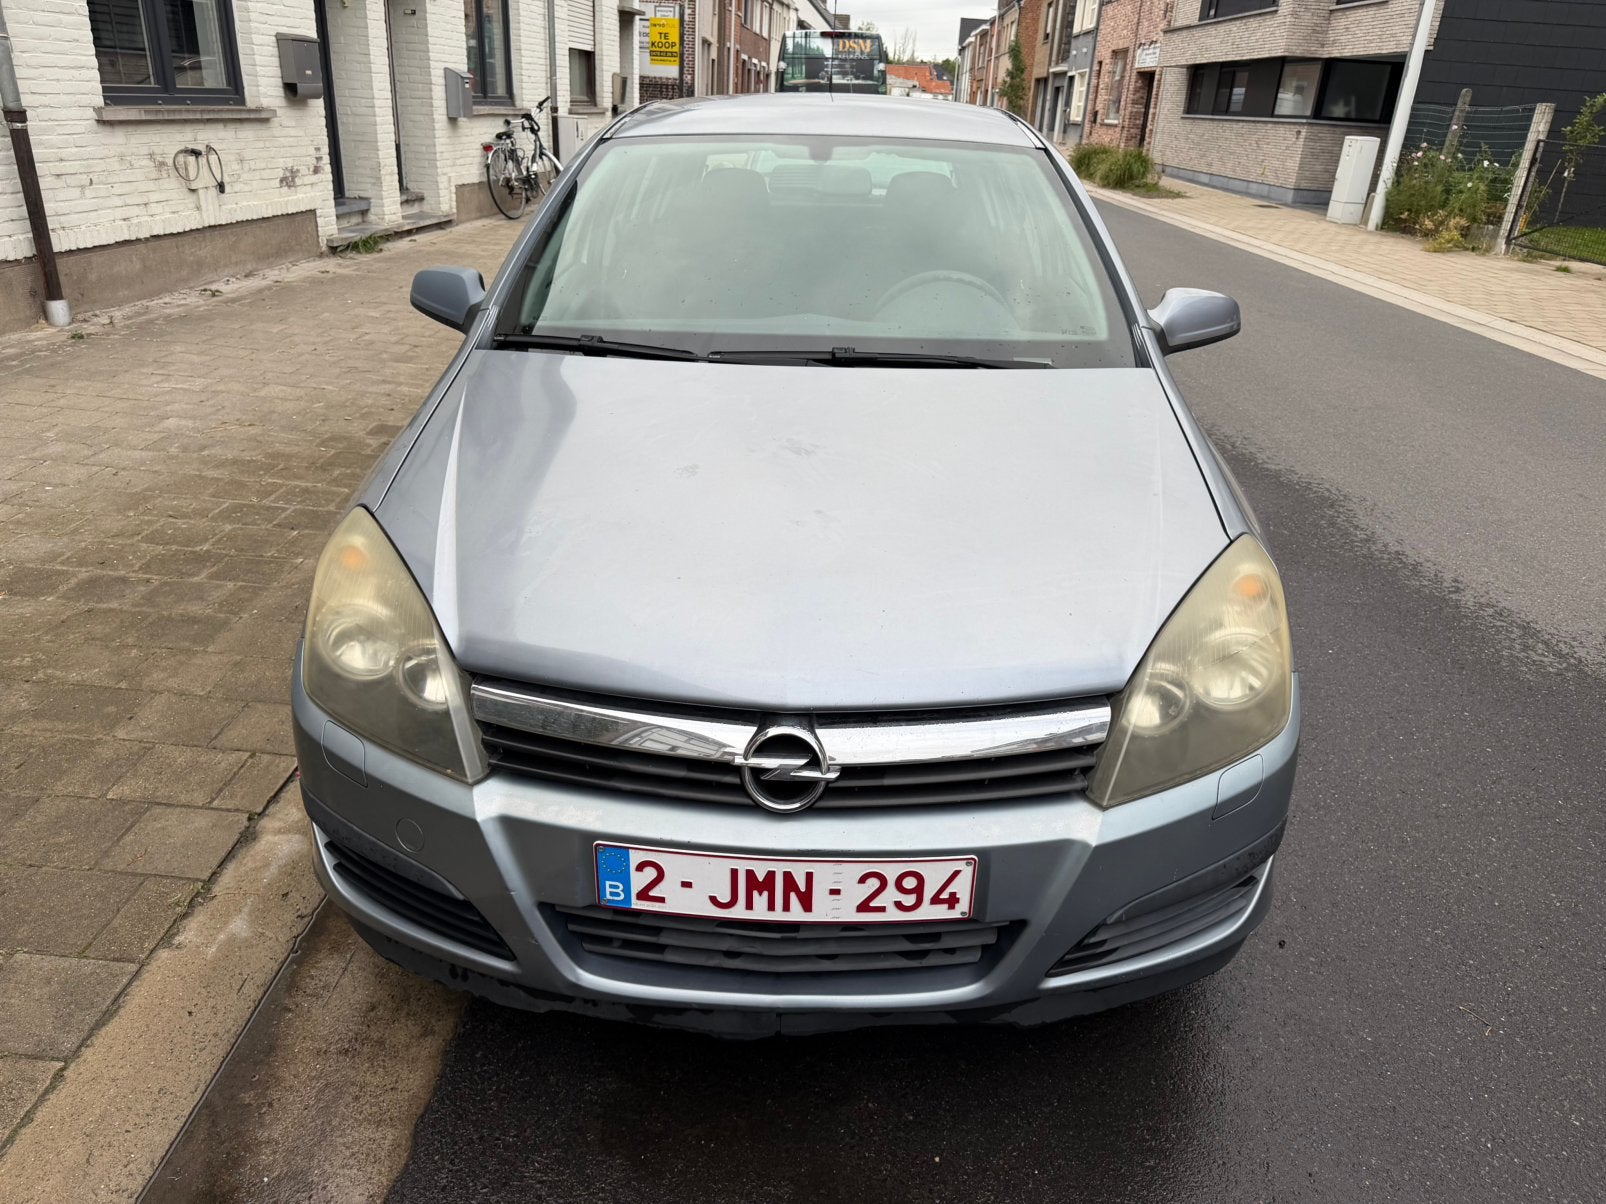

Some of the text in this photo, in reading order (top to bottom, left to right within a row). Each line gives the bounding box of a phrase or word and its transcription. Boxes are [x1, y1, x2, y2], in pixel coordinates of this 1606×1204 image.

[658, 32, 670, 40] TE
[651, 41, 677, 49] KOOP
[839, 39, 871, 52] DSM
[605, 880, 625, 901] B
